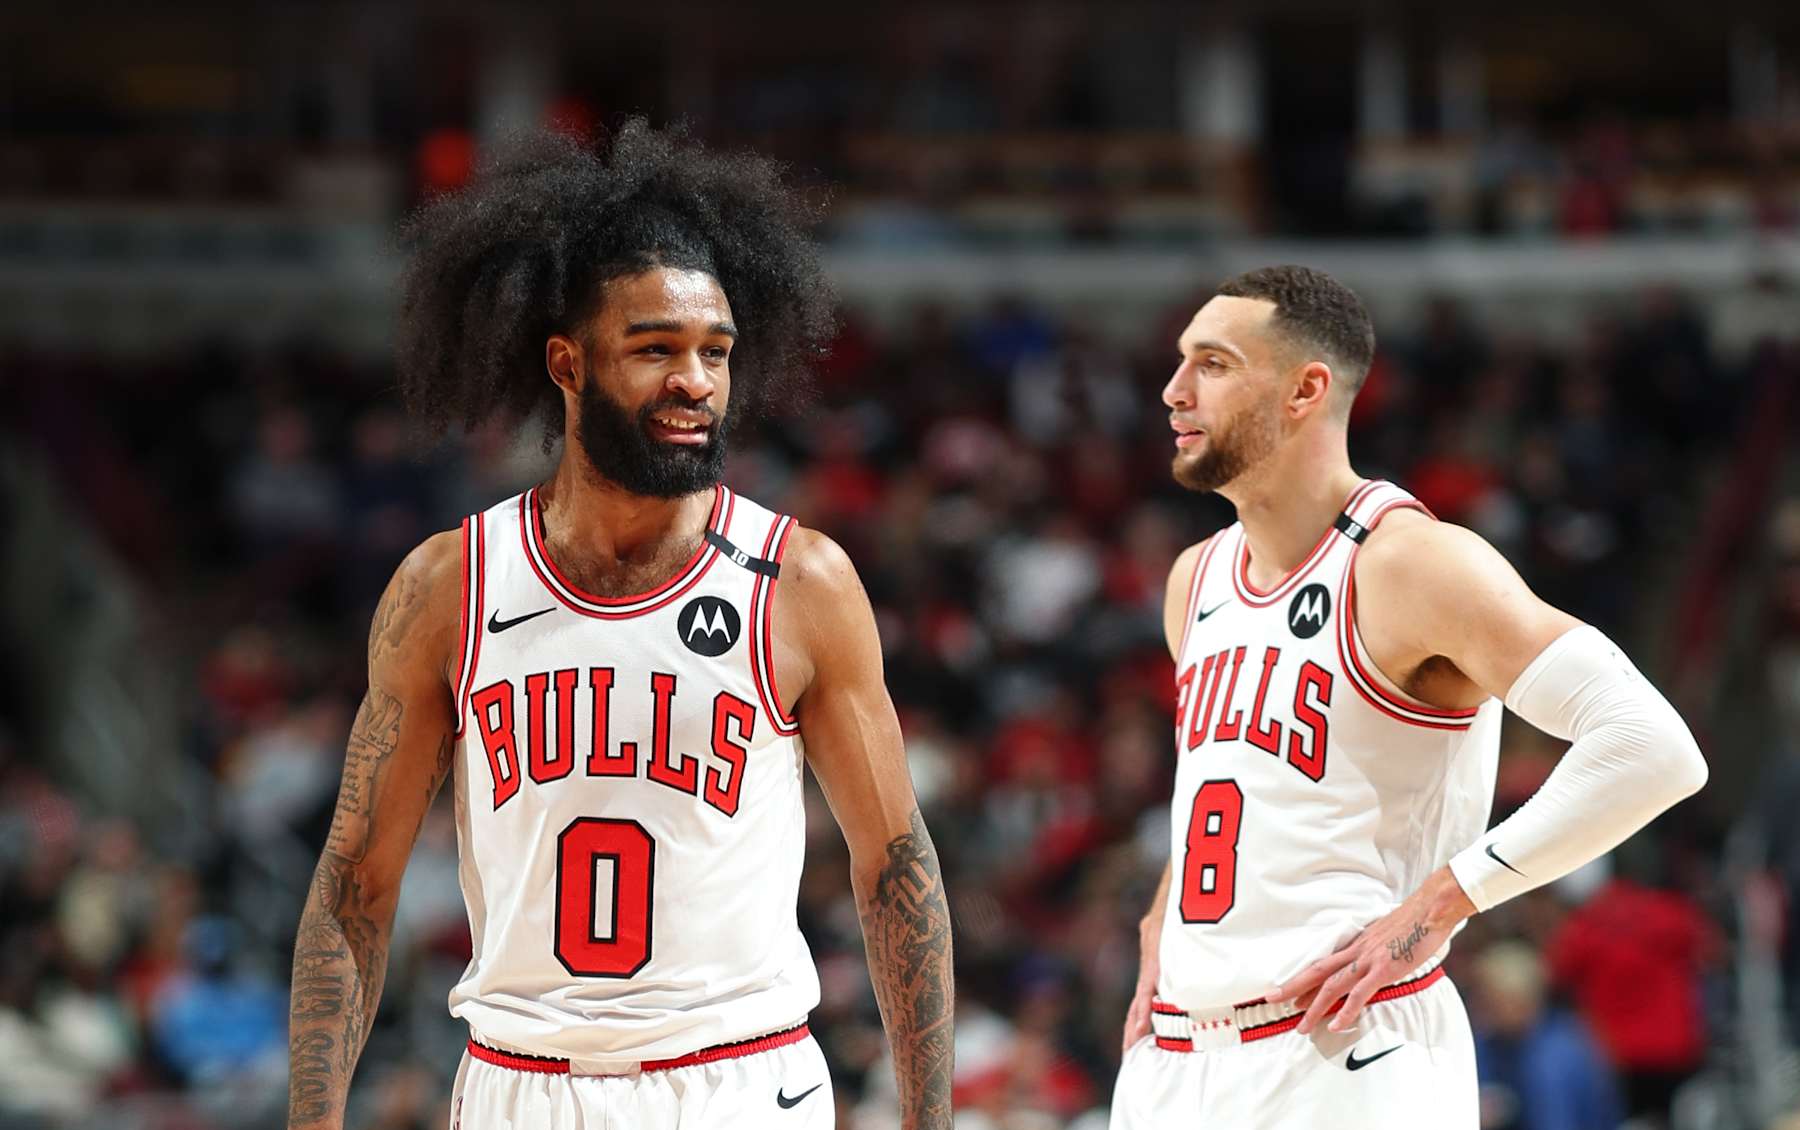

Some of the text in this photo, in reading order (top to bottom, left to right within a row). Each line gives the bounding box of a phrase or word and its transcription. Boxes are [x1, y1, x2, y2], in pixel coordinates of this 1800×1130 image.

[687, 604, 731, 643] M
[730, 548, 749, 567] 10
[470, 667, 757, 818] BULLS
[554, 816, 656, 979] 0
[1179, 778, 1244, 924] 8
